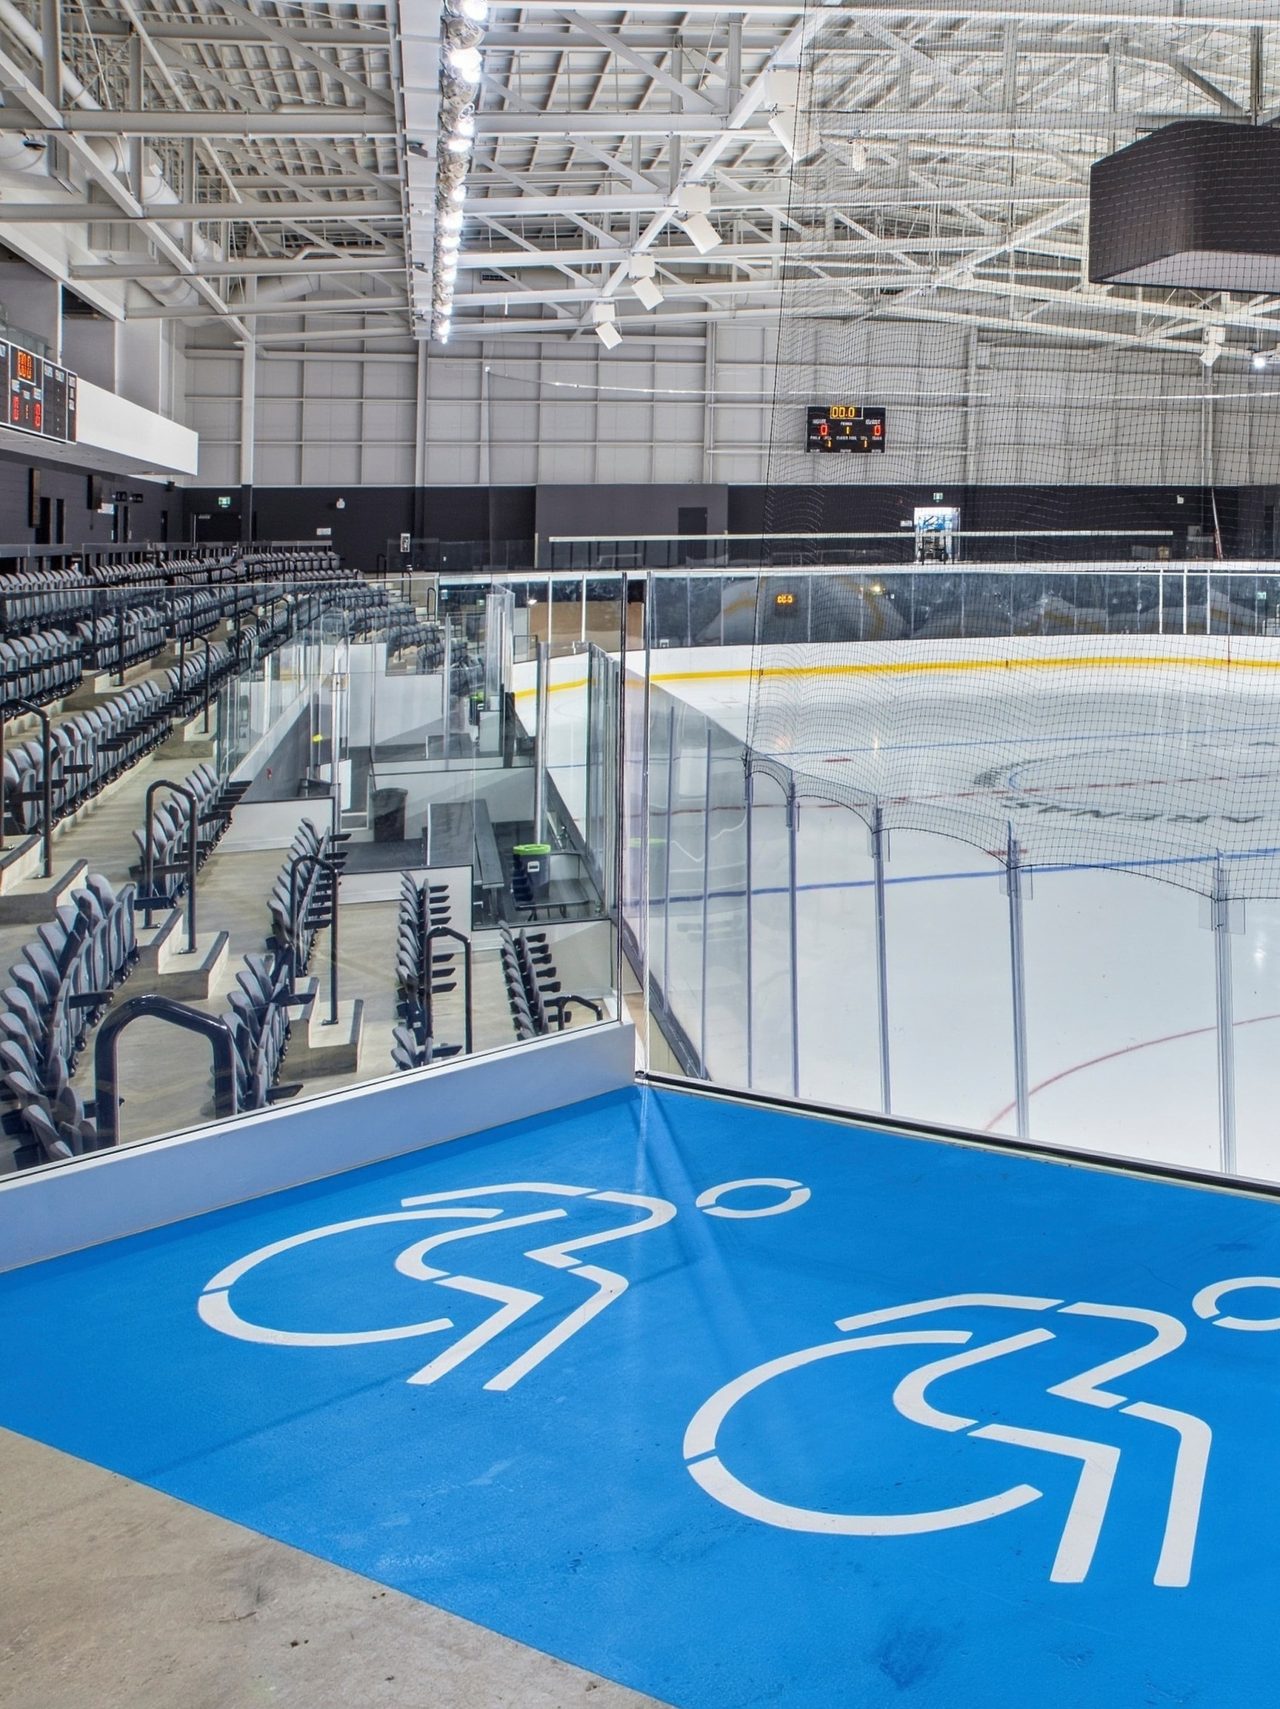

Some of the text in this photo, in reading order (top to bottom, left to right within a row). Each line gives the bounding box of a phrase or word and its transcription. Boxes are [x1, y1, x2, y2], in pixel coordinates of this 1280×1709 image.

[832, 406, 855, 418] 00.0
[820, 424, 828, 436] 0
[874, 424, 881, 436] 0
[1002, 801, 1264, 824] ARENAS
